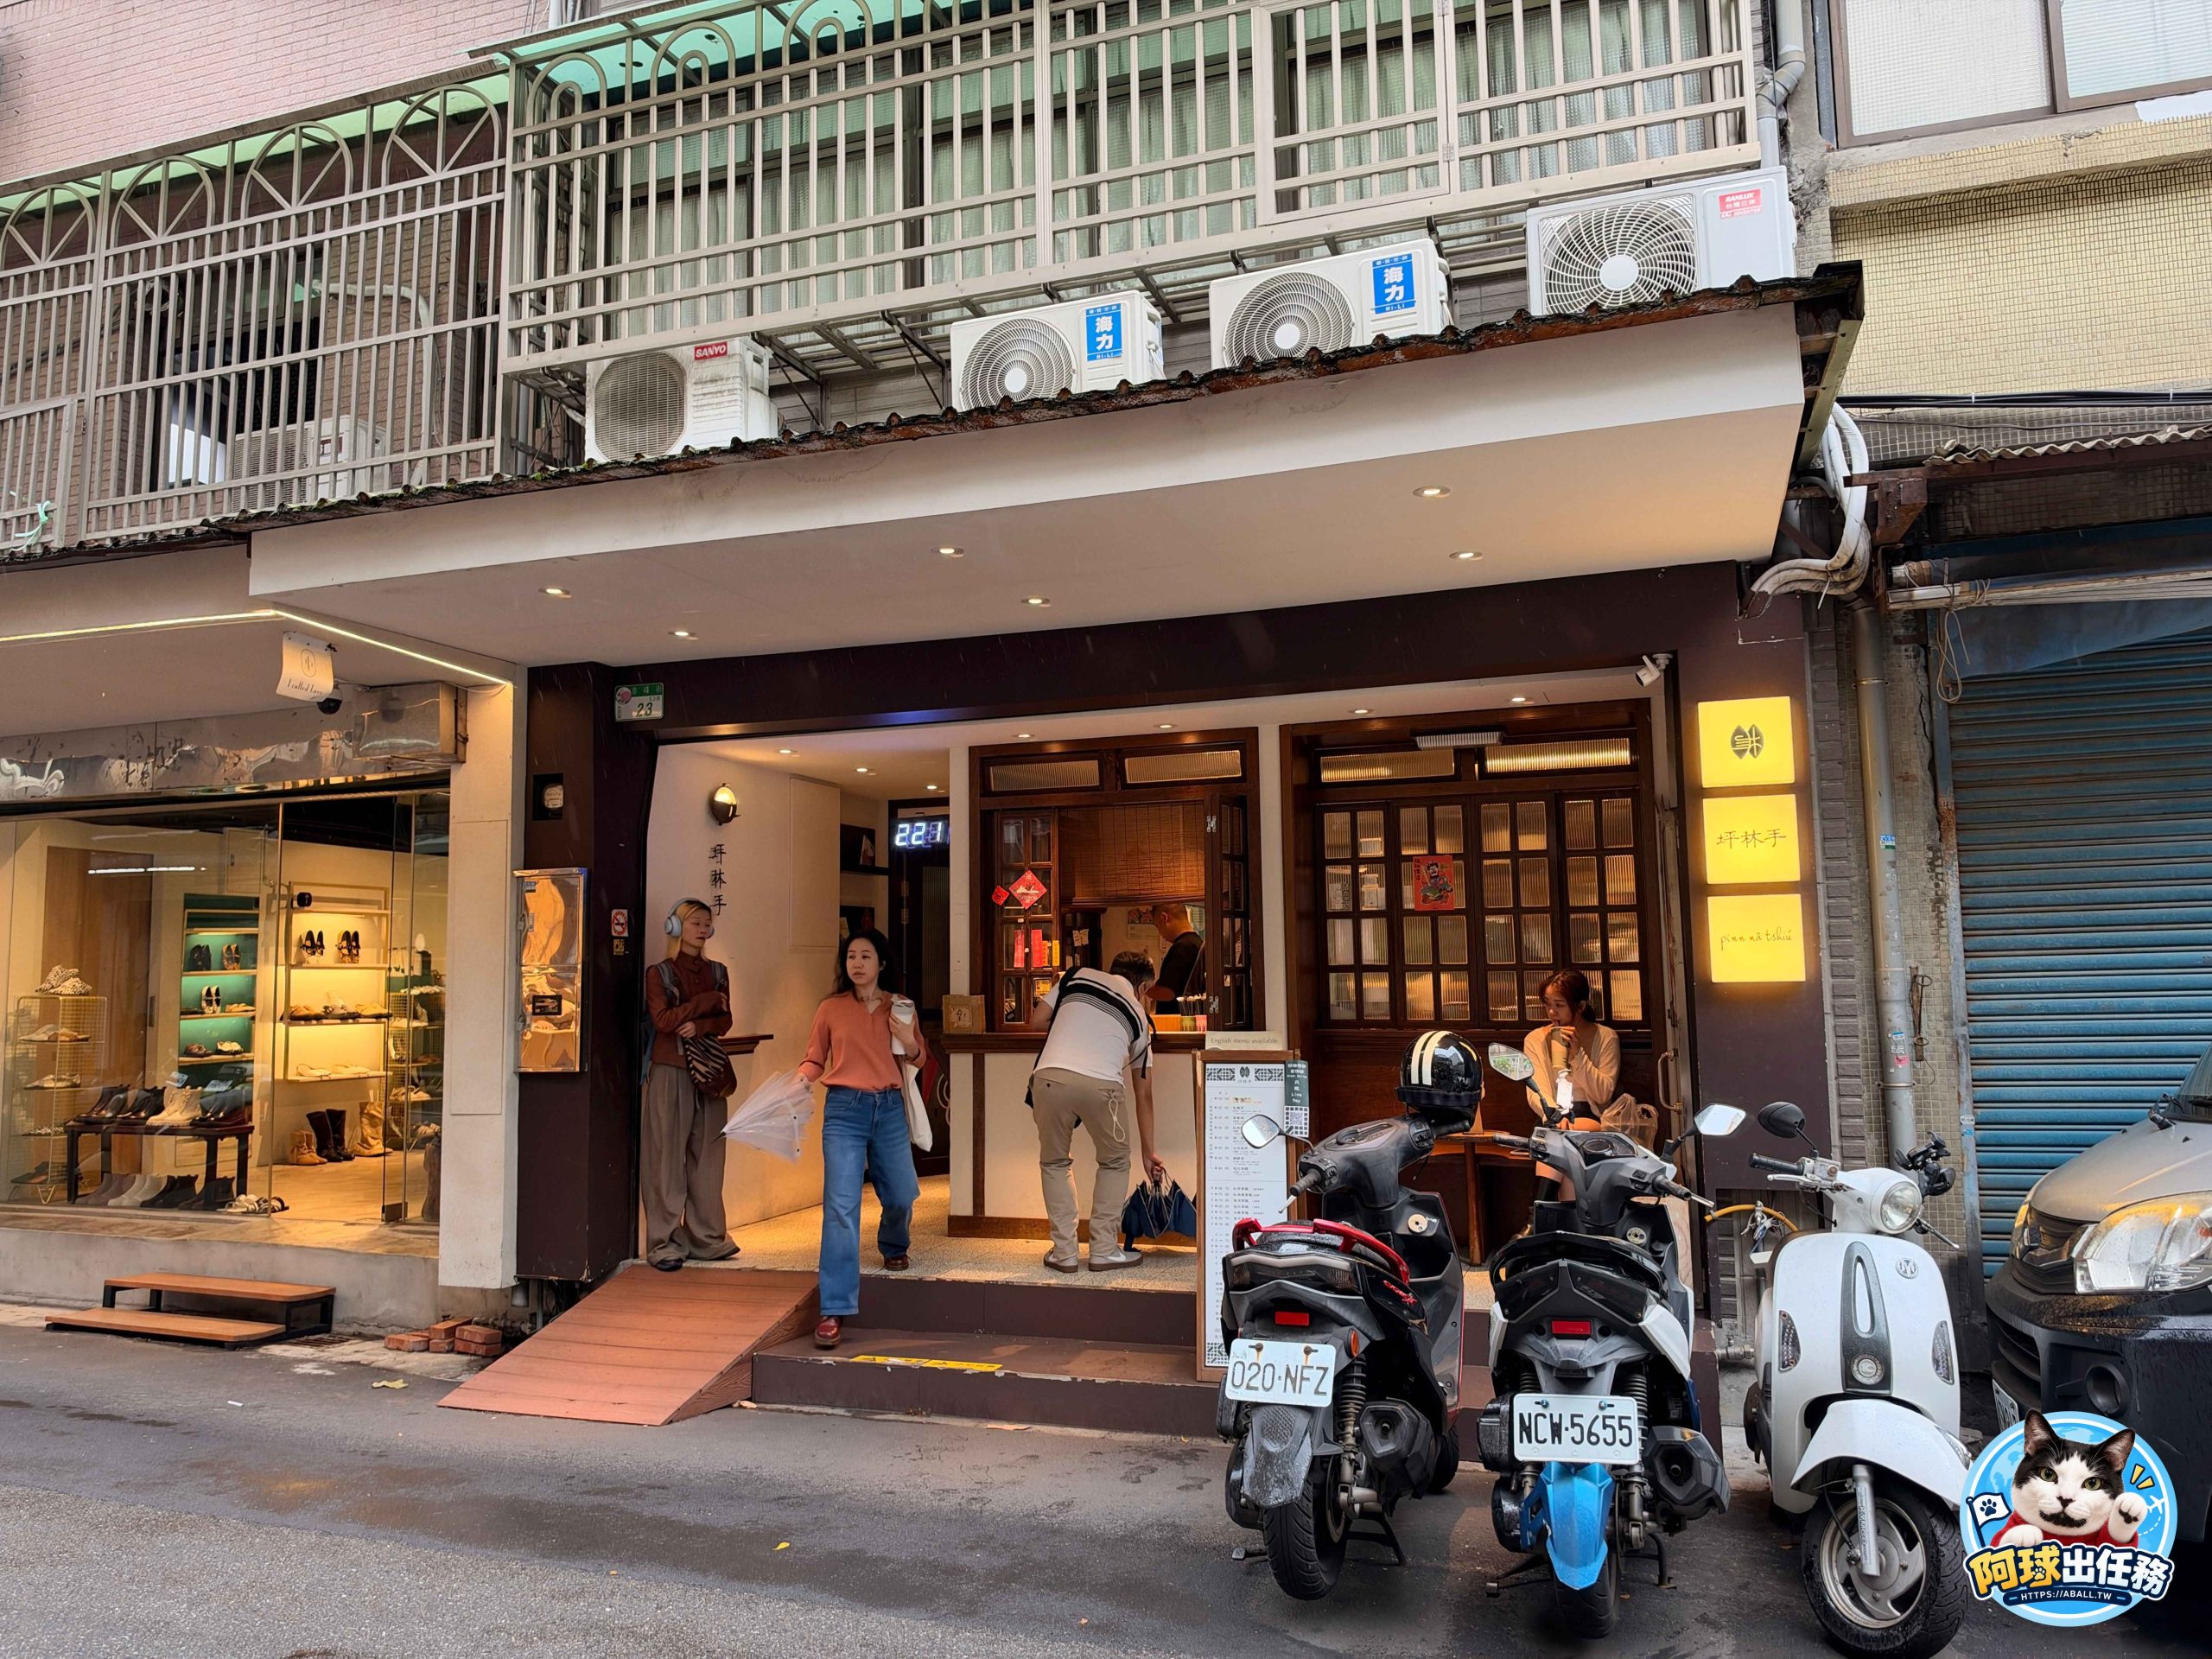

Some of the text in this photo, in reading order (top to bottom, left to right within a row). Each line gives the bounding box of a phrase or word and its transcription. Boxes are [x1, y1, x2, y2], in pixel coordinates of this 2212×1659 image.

[1383, 266, 1404, 302] 海力
[696, 344, 727, 358] SANYO
[1096, 315, 1113, 351] 海力
[636, 702, 653, 718] 23
[1715, 829, 1787, 849] 坪林手
[709, 843, 727, 916] 坪林手
[1858, 1505, 1868, 1546] KYMCO
